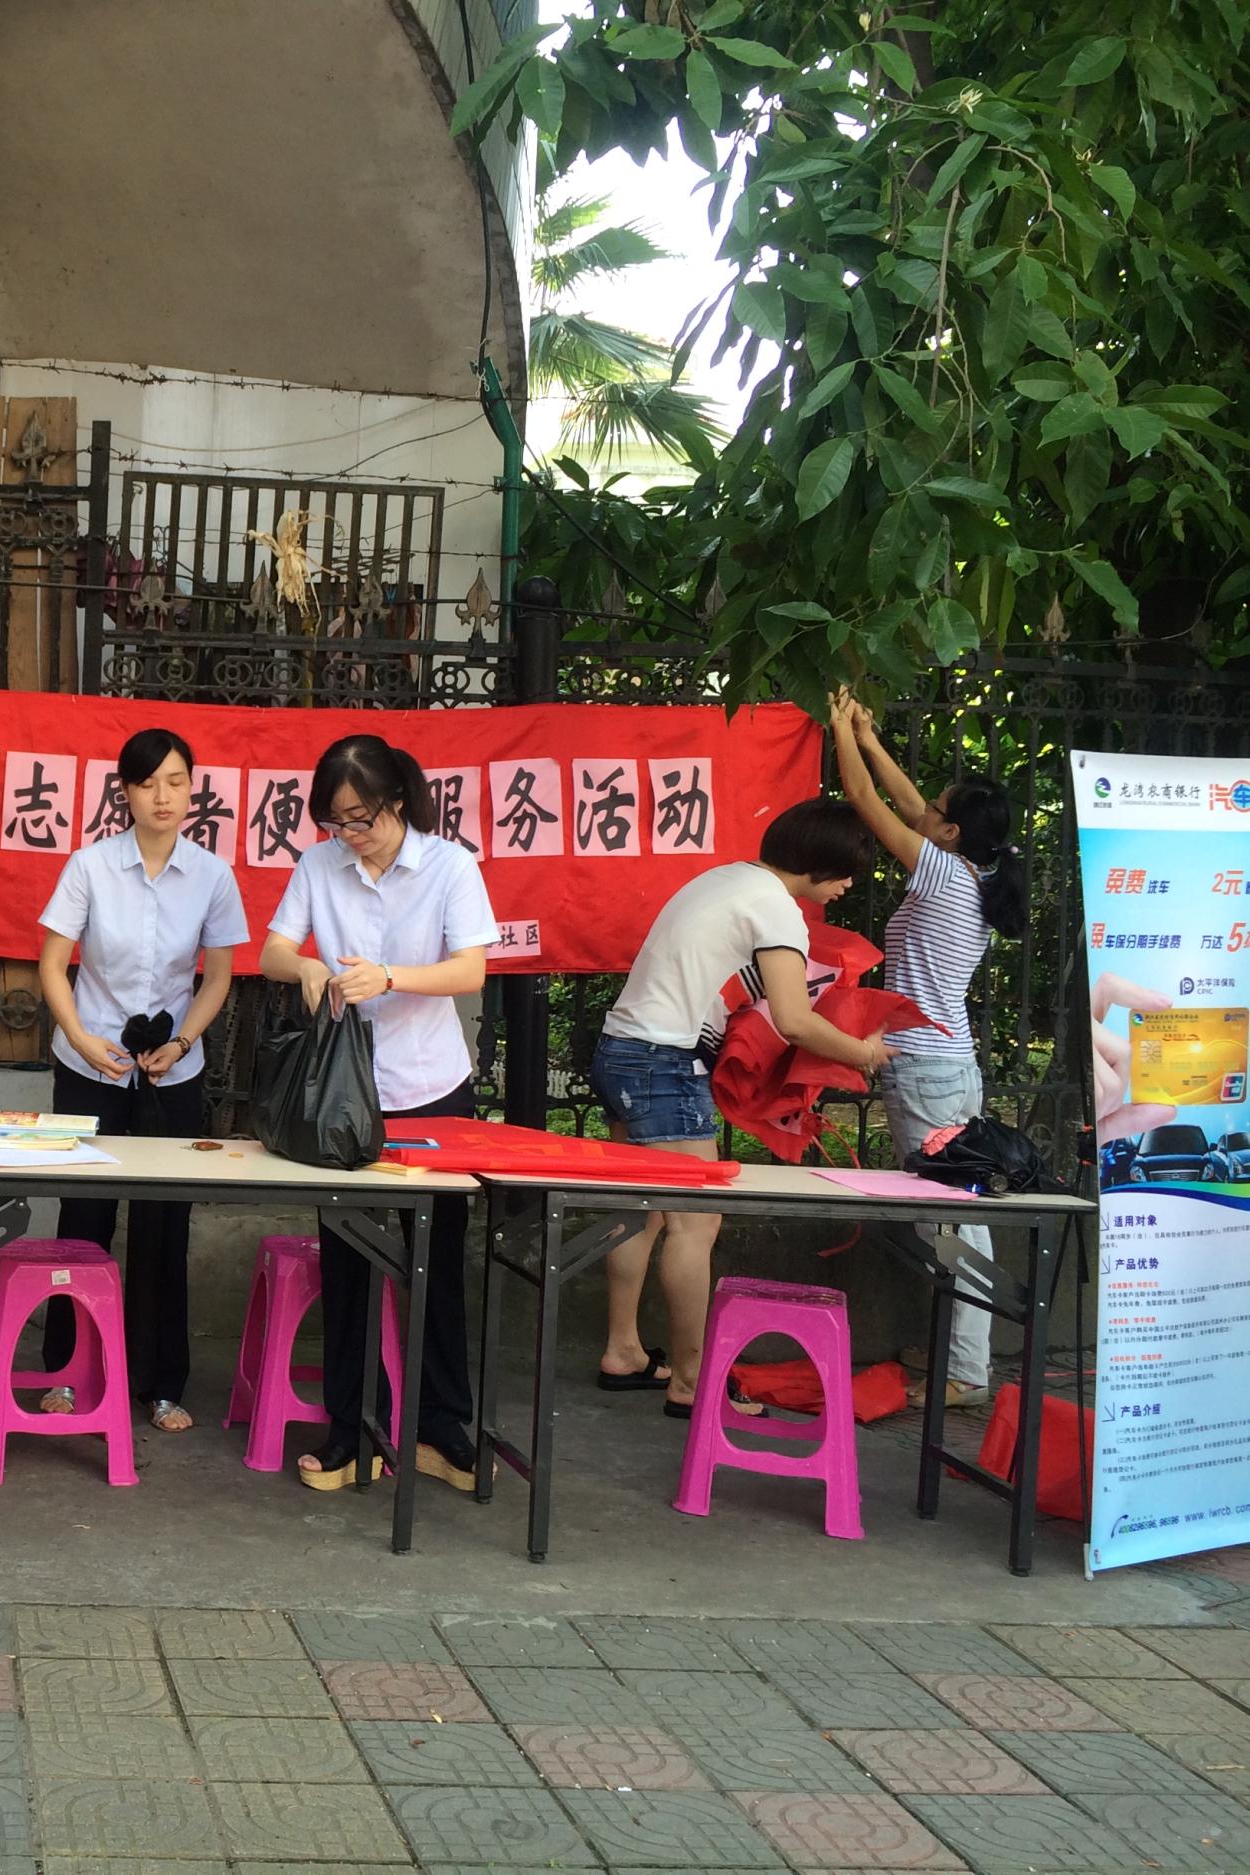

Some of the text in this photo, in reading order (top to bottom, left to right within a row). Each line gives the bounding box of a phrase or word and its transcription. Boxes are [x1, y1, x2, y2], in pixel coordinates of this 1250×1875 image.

[1119, 782, 1201, 800] 龙湾农商银行
[486, 924, 540, 949] 社区
[1114, 1214, 1158, 1228] 适用对象
[1115, 1257, 1160, 1271] 产品优势
[1120, 1403, 1162, 1418] 产品介绍
